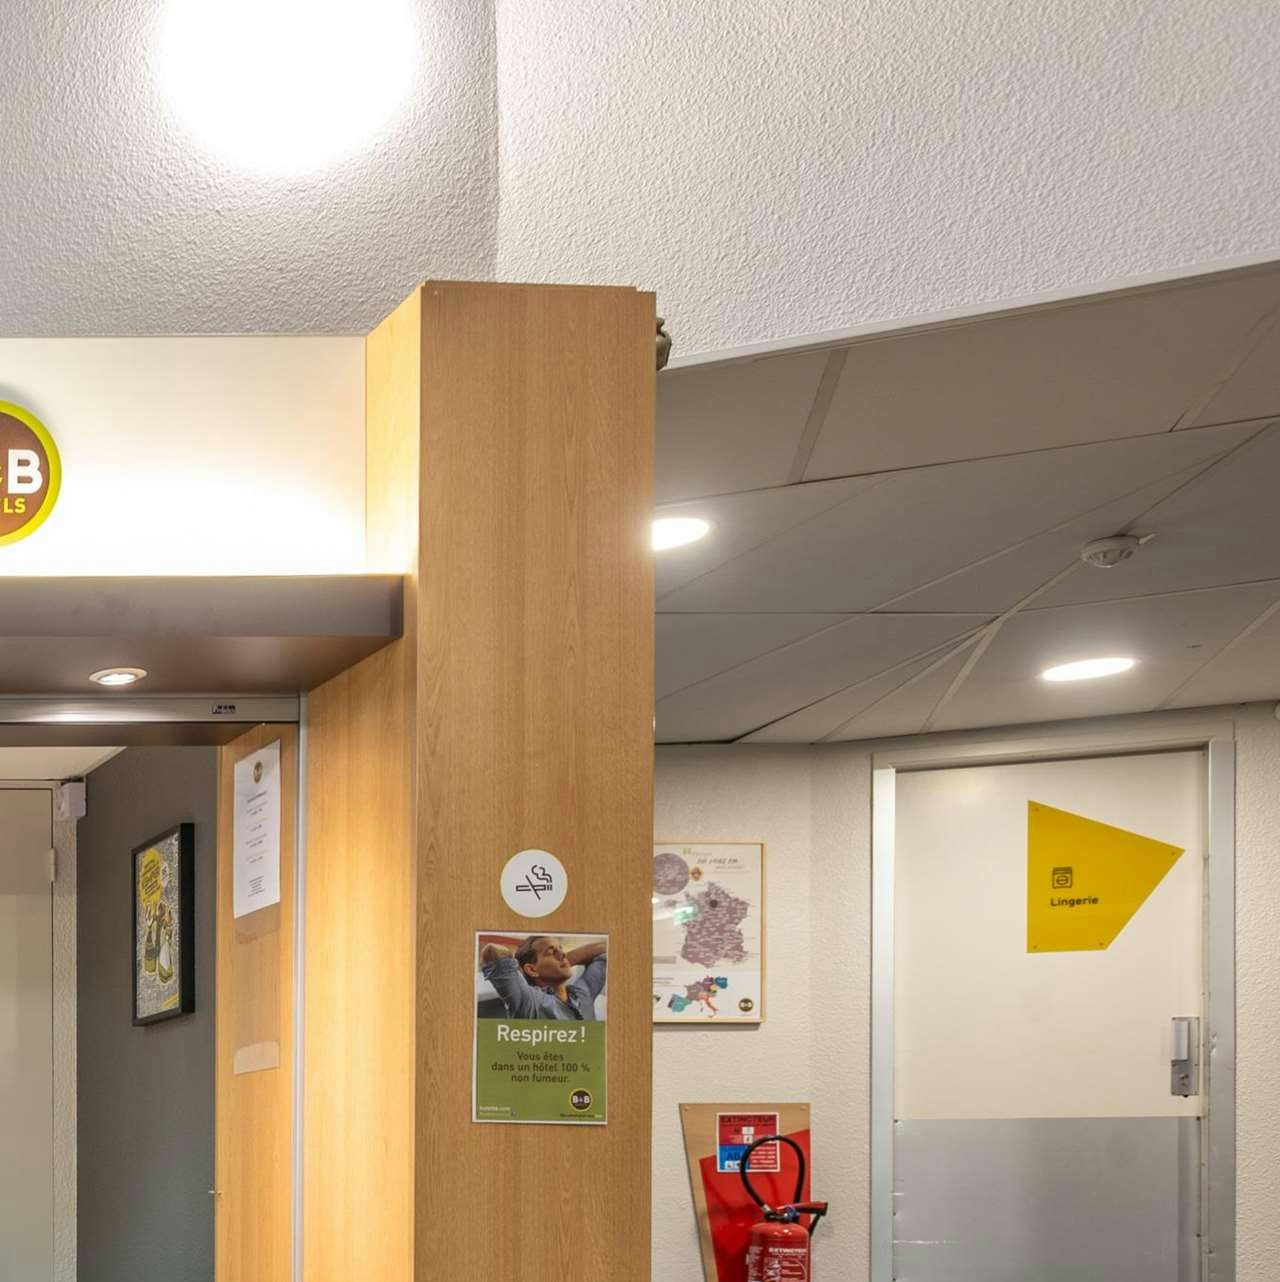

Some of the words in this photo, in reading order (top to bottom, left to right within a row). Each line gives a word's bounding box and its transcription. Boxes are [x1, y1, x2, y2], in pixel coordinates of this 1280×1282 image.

[1050, 896, 1100, 908] Lingerie
[497, 1024, 577, 1046] Respirez
[516, 1052, 541, 1061] Vous
[543, 1052, 564, 1062] êtes
[491, 1062, 514, 1072] dans
[517, 1064, 530, 1072] un
[532, 1061, 558, 1072] hôtel
[562, 1063, 578, 1073] 100
[511, 1074, 529, 1082] non
